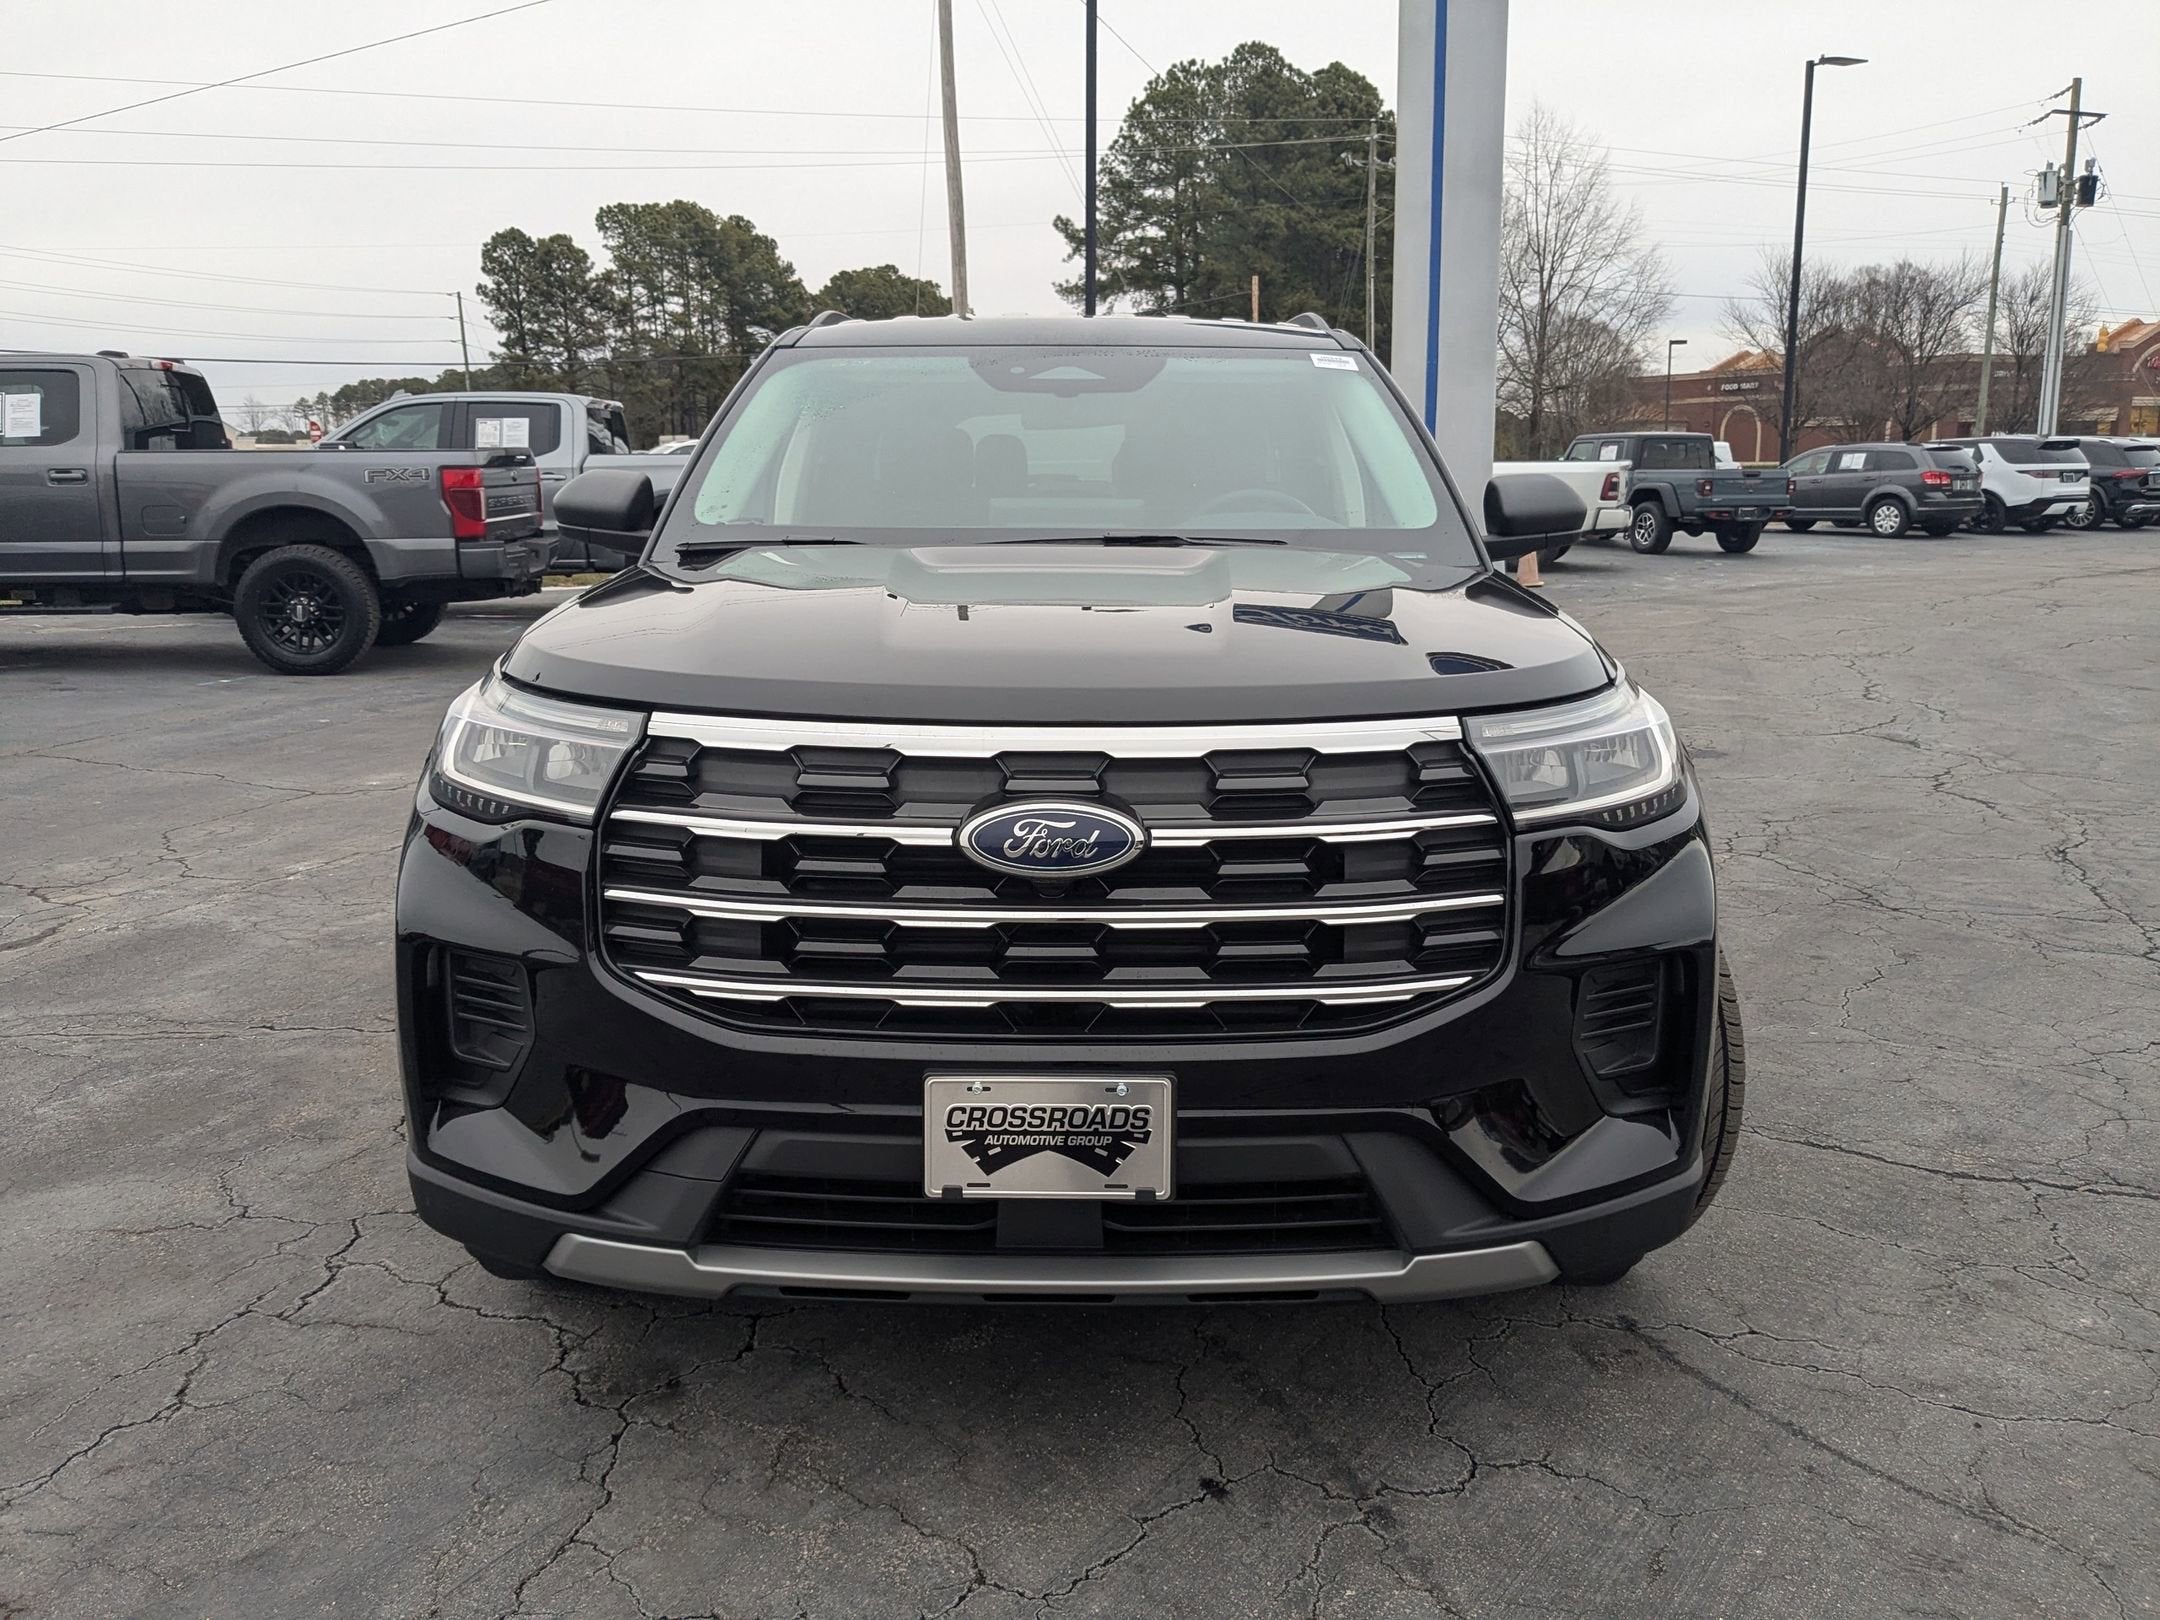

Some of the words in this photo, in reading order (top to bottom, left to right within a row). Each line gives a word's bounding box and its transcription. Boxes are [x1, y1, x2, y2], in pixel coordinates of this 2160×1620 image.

[364, 468, 431, 484] FX4
[1003, 818, 1100, 859] Ford
[945, 1105, 1151, 1131] CROSSROADS
[984, 1134, 1065, 1147] AUTOMOTIVE
[1067, 1135, 1113, 1147] GROUP
